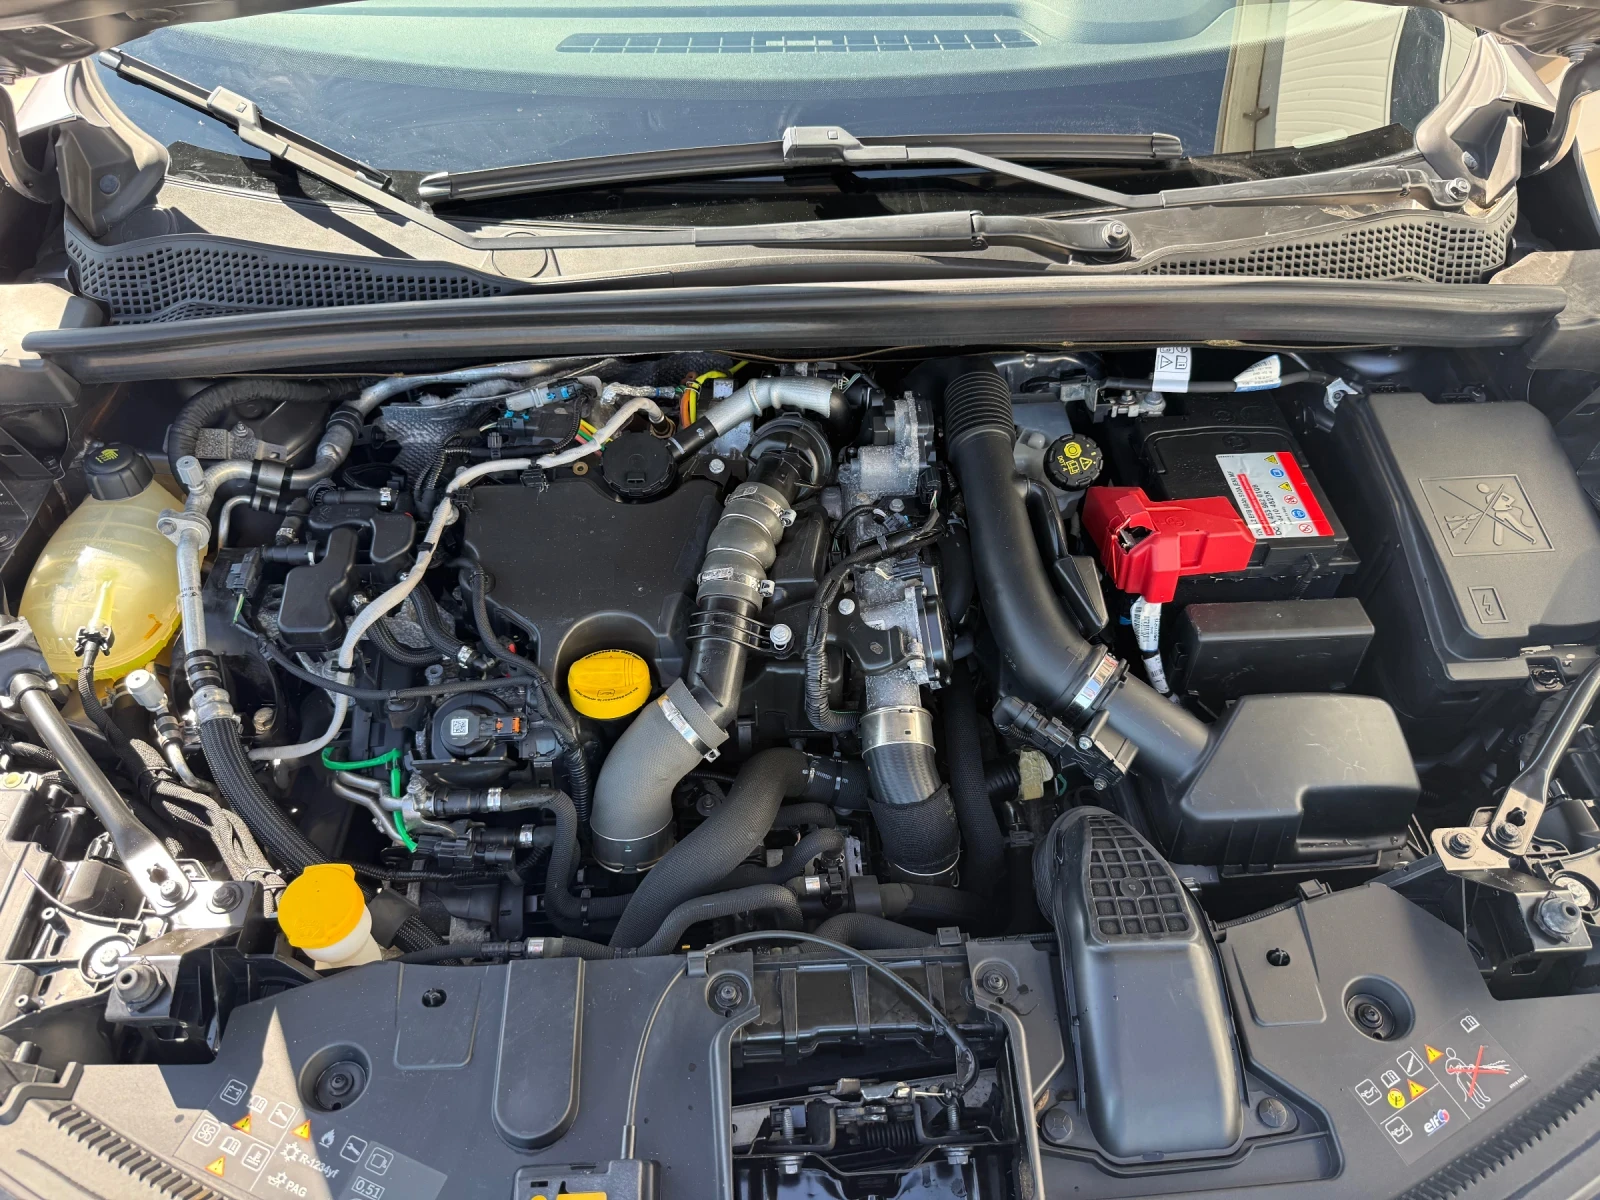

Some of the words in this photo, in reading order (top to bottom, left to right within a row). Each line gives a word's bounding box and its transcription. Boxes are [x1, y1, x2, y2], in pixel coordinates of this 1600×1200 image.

[1423, 1114, 1441, 1133] elf
[298, 1153, 340, 1178] R-1234yf
[285, 1180, 308, 1198] PAG
[355, 1179, 381, 1199] 0,51
